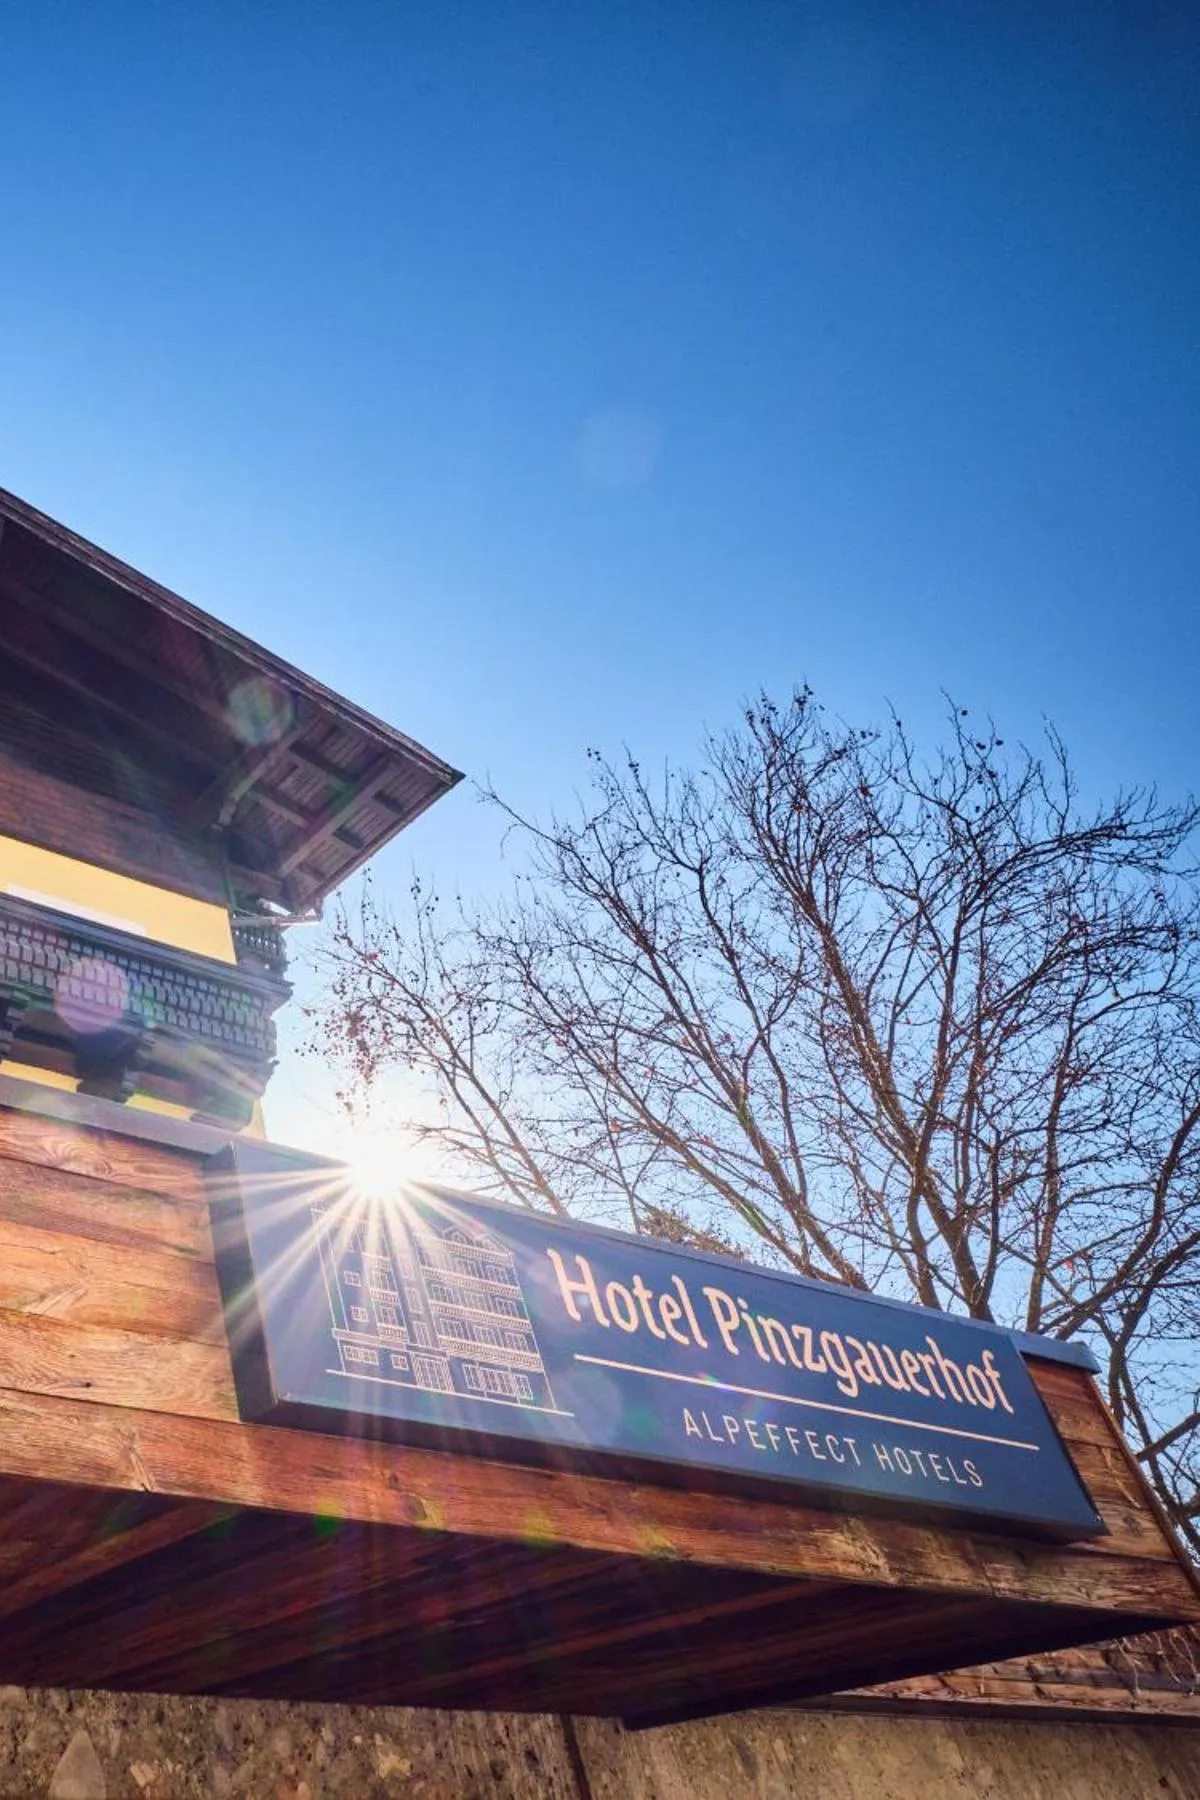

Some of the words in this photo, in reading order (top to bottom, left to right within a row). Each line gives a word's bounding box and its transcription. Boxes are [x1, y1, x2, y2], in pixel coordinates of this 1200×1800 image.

[547, 1248, 708, 1350] Hotel
[703, 1286, 1015, 1414] Pinzgauerhof
[682, 1408, 862, 1467] ALPEFFECT
[873, 1443, 984, 1488] HOTELS
